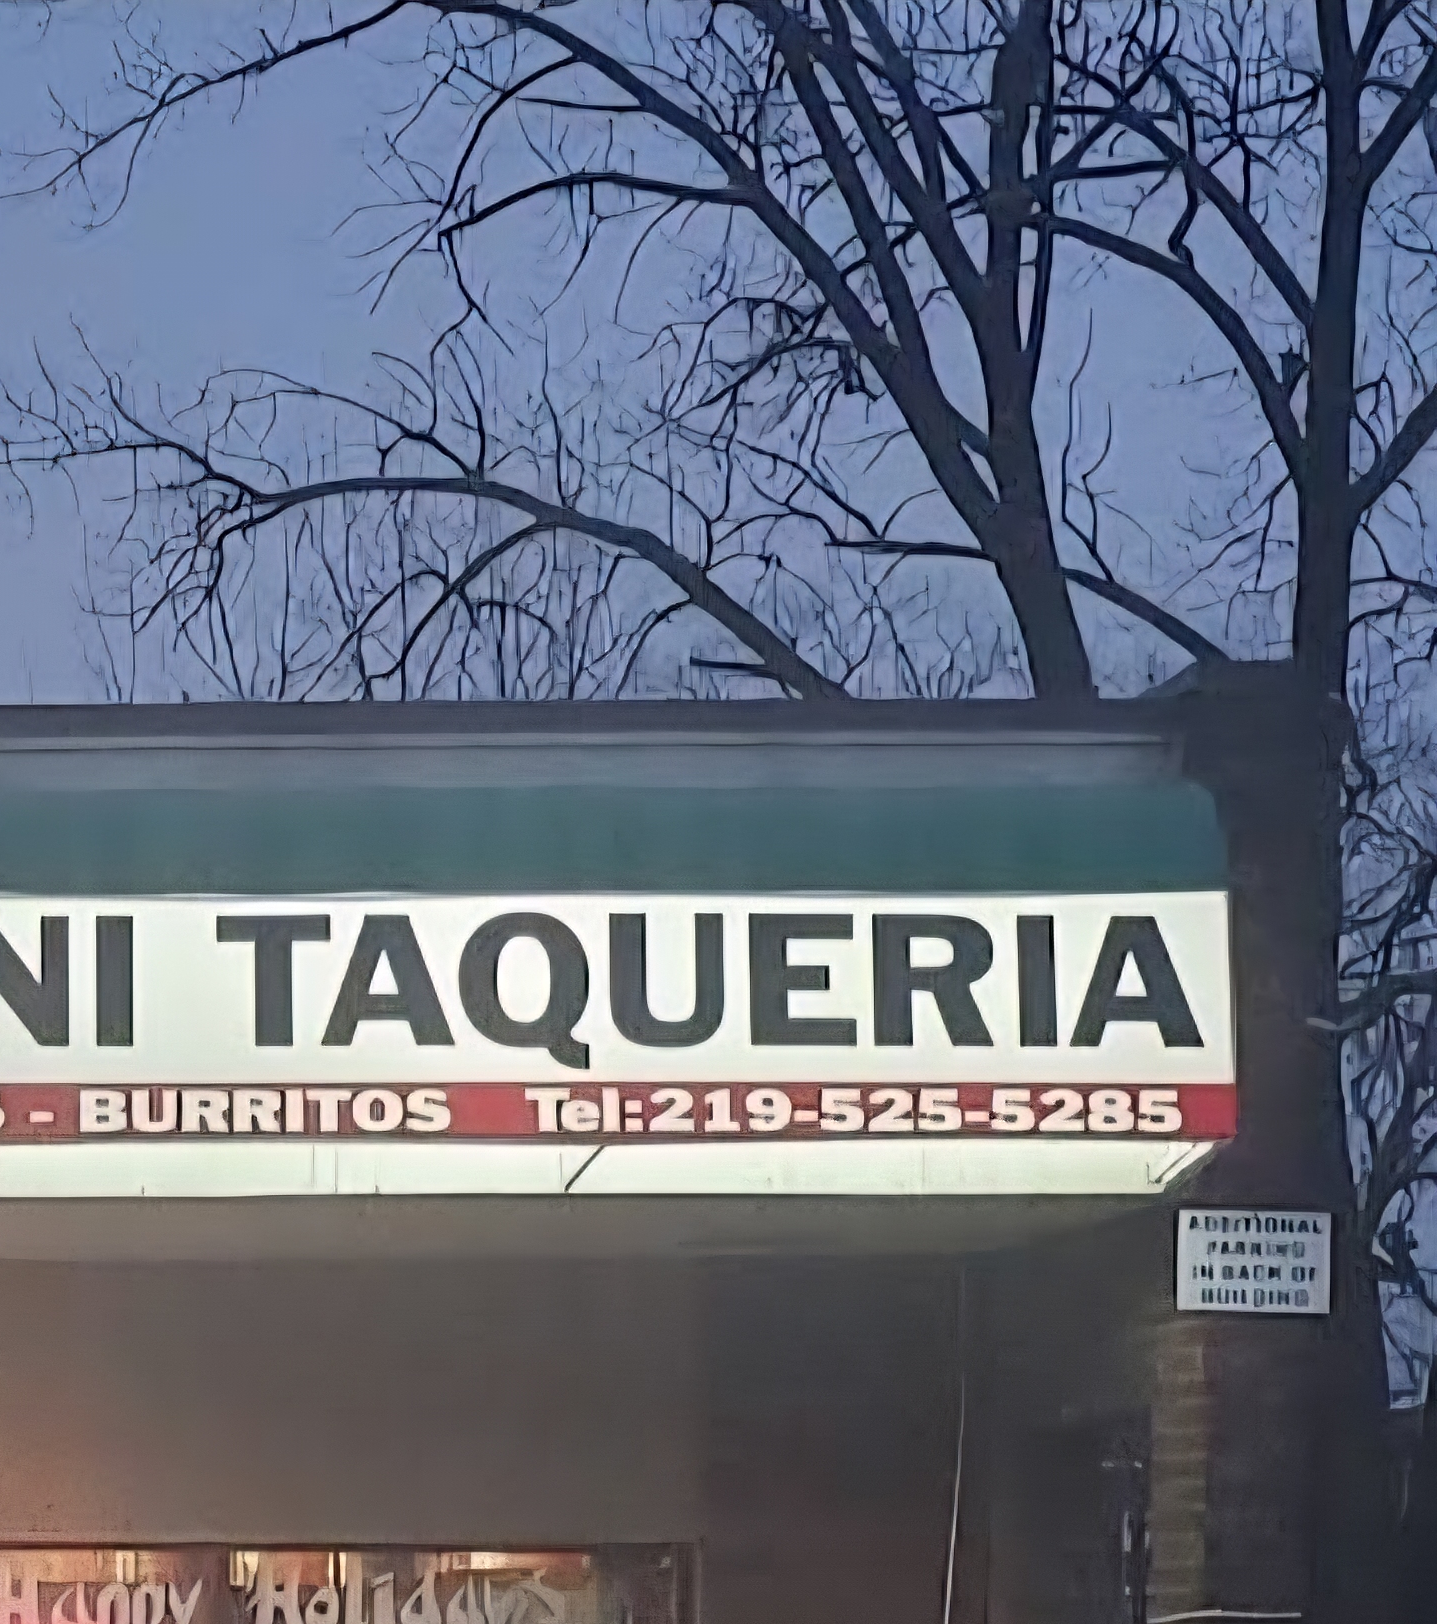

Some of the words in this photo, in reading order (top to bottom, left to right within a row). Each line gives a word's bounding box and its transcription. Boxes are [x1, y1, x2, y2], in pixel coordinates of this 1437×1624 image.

[216, 911, 1205, 1069] TAQUERIA
[79, 1088, 451, 1133] BURRITOS
[525, 1087, 1183, 1134] Tel:219-525-5285
